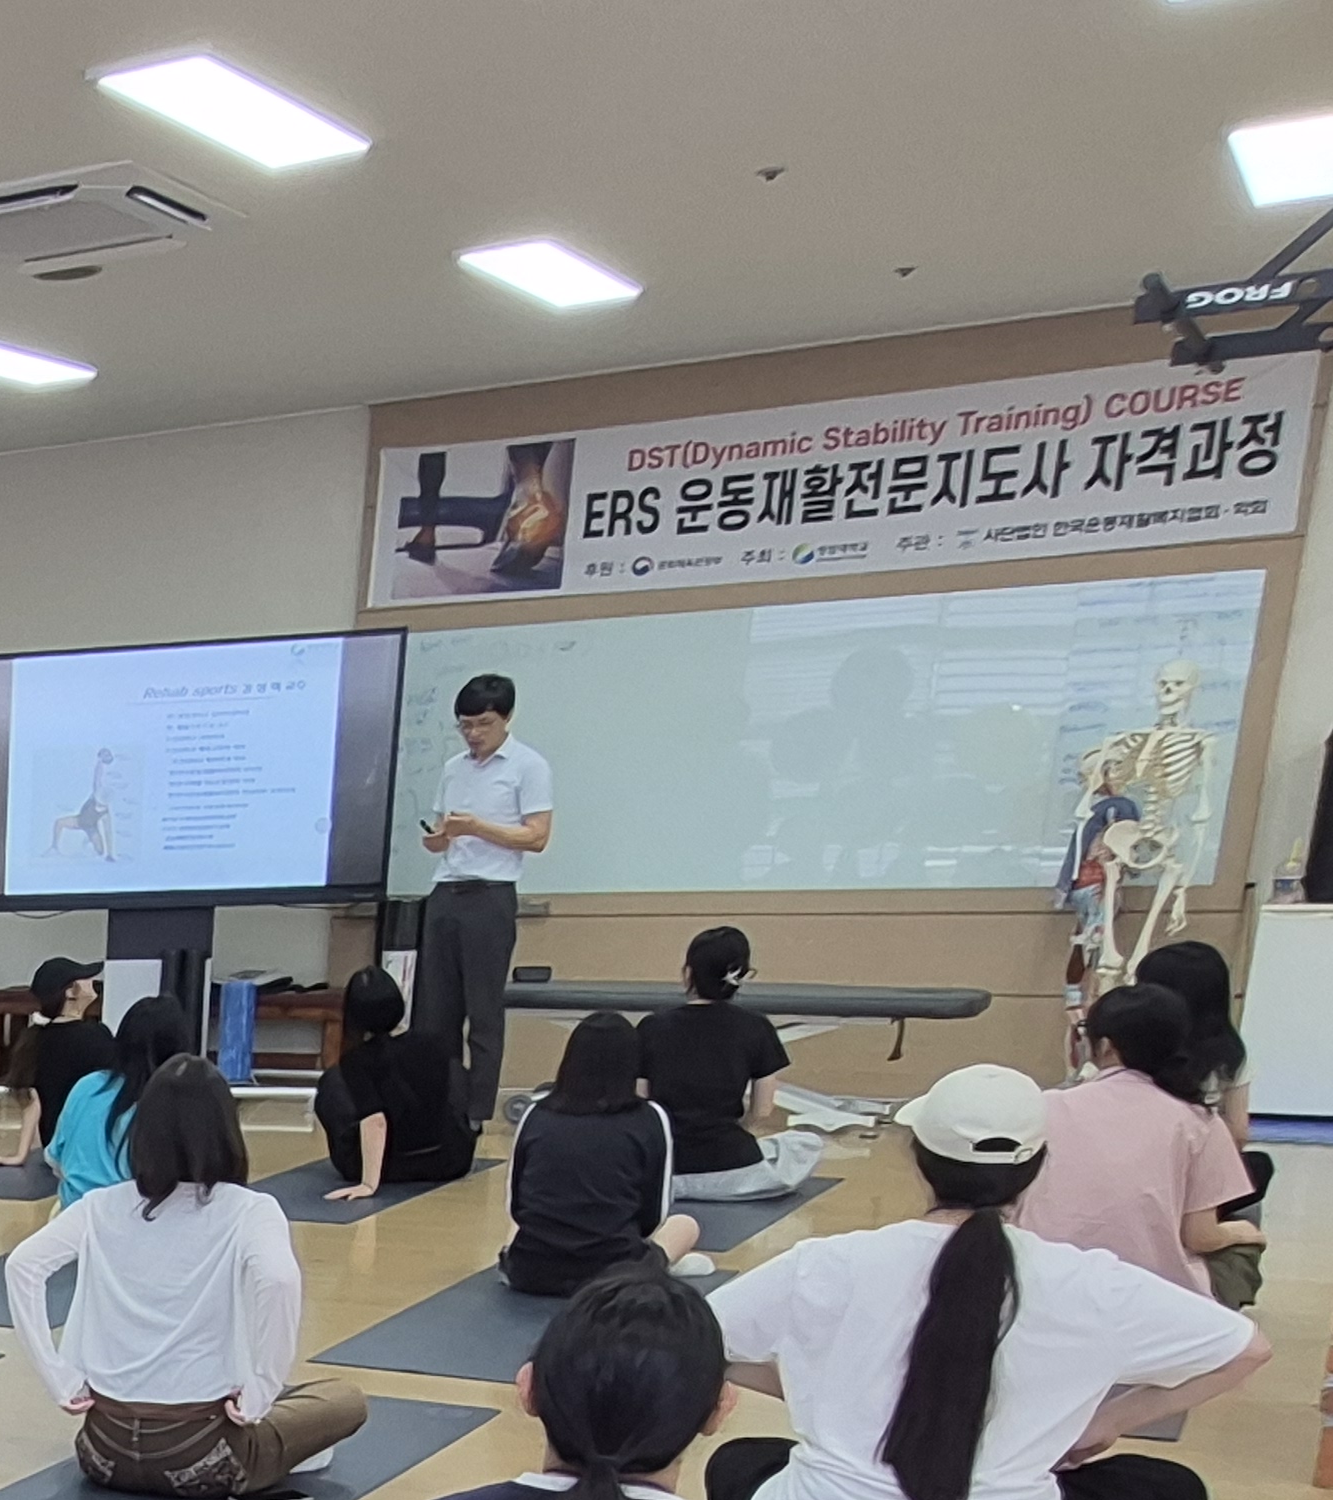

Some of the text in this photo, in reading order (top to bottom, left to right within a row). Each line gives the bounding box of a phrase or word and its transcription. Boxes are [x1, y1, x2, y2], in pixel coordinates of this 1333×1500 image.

[1185, 279, 1298, 309] FROG
[627, 376, 1246, 472] DST(Dynamic Stability Training) COURSE
[582, 409, 1287, 540] ERS 운동재활전문지도사 자격과정
[896, 533, 931, 551] 주관
